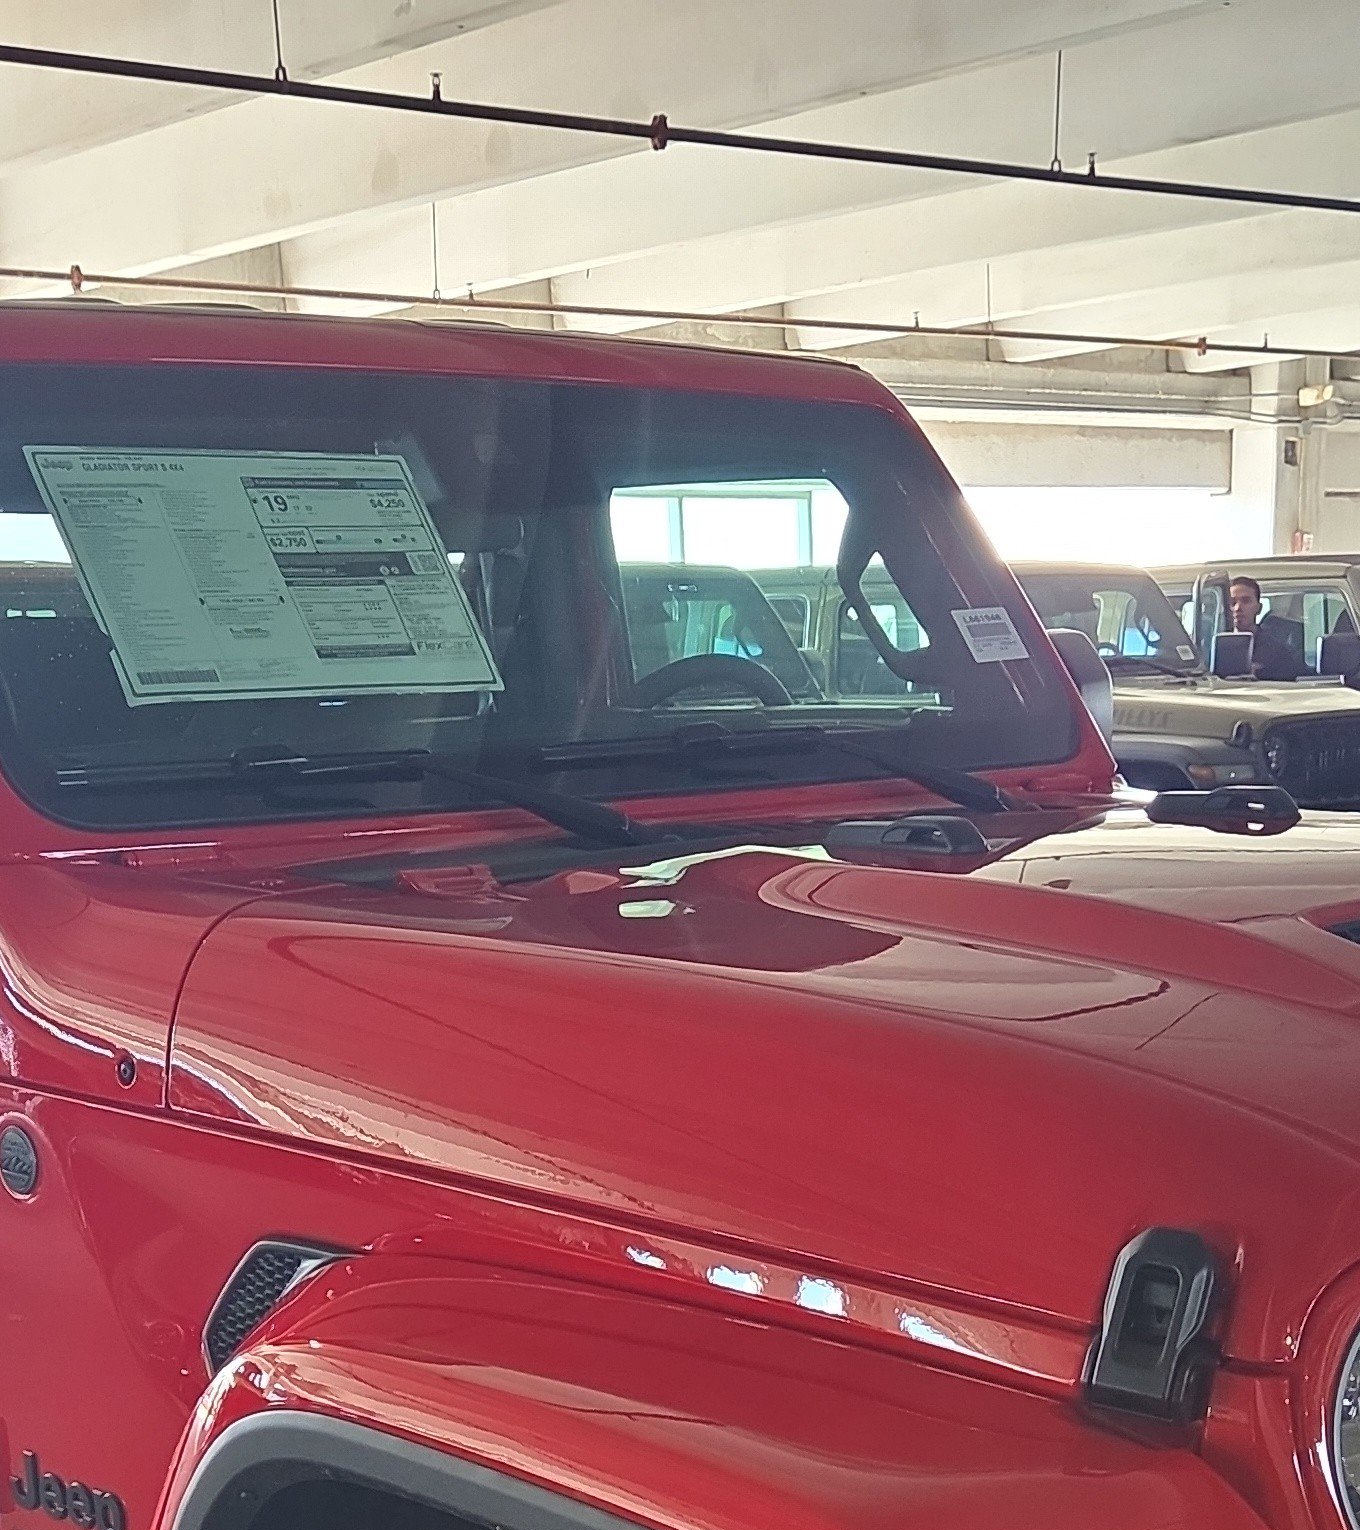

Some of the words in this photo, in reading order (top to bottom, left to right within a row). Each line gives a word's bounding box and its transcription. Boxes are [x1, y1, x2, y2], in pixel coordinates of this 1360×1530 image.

[261, 494, 289, 513] 19
[369, 498, 405, 510] $4,250
[269, 537, 308, 549] $2,750
[1113, 709, 1174, 727] ILLYS
